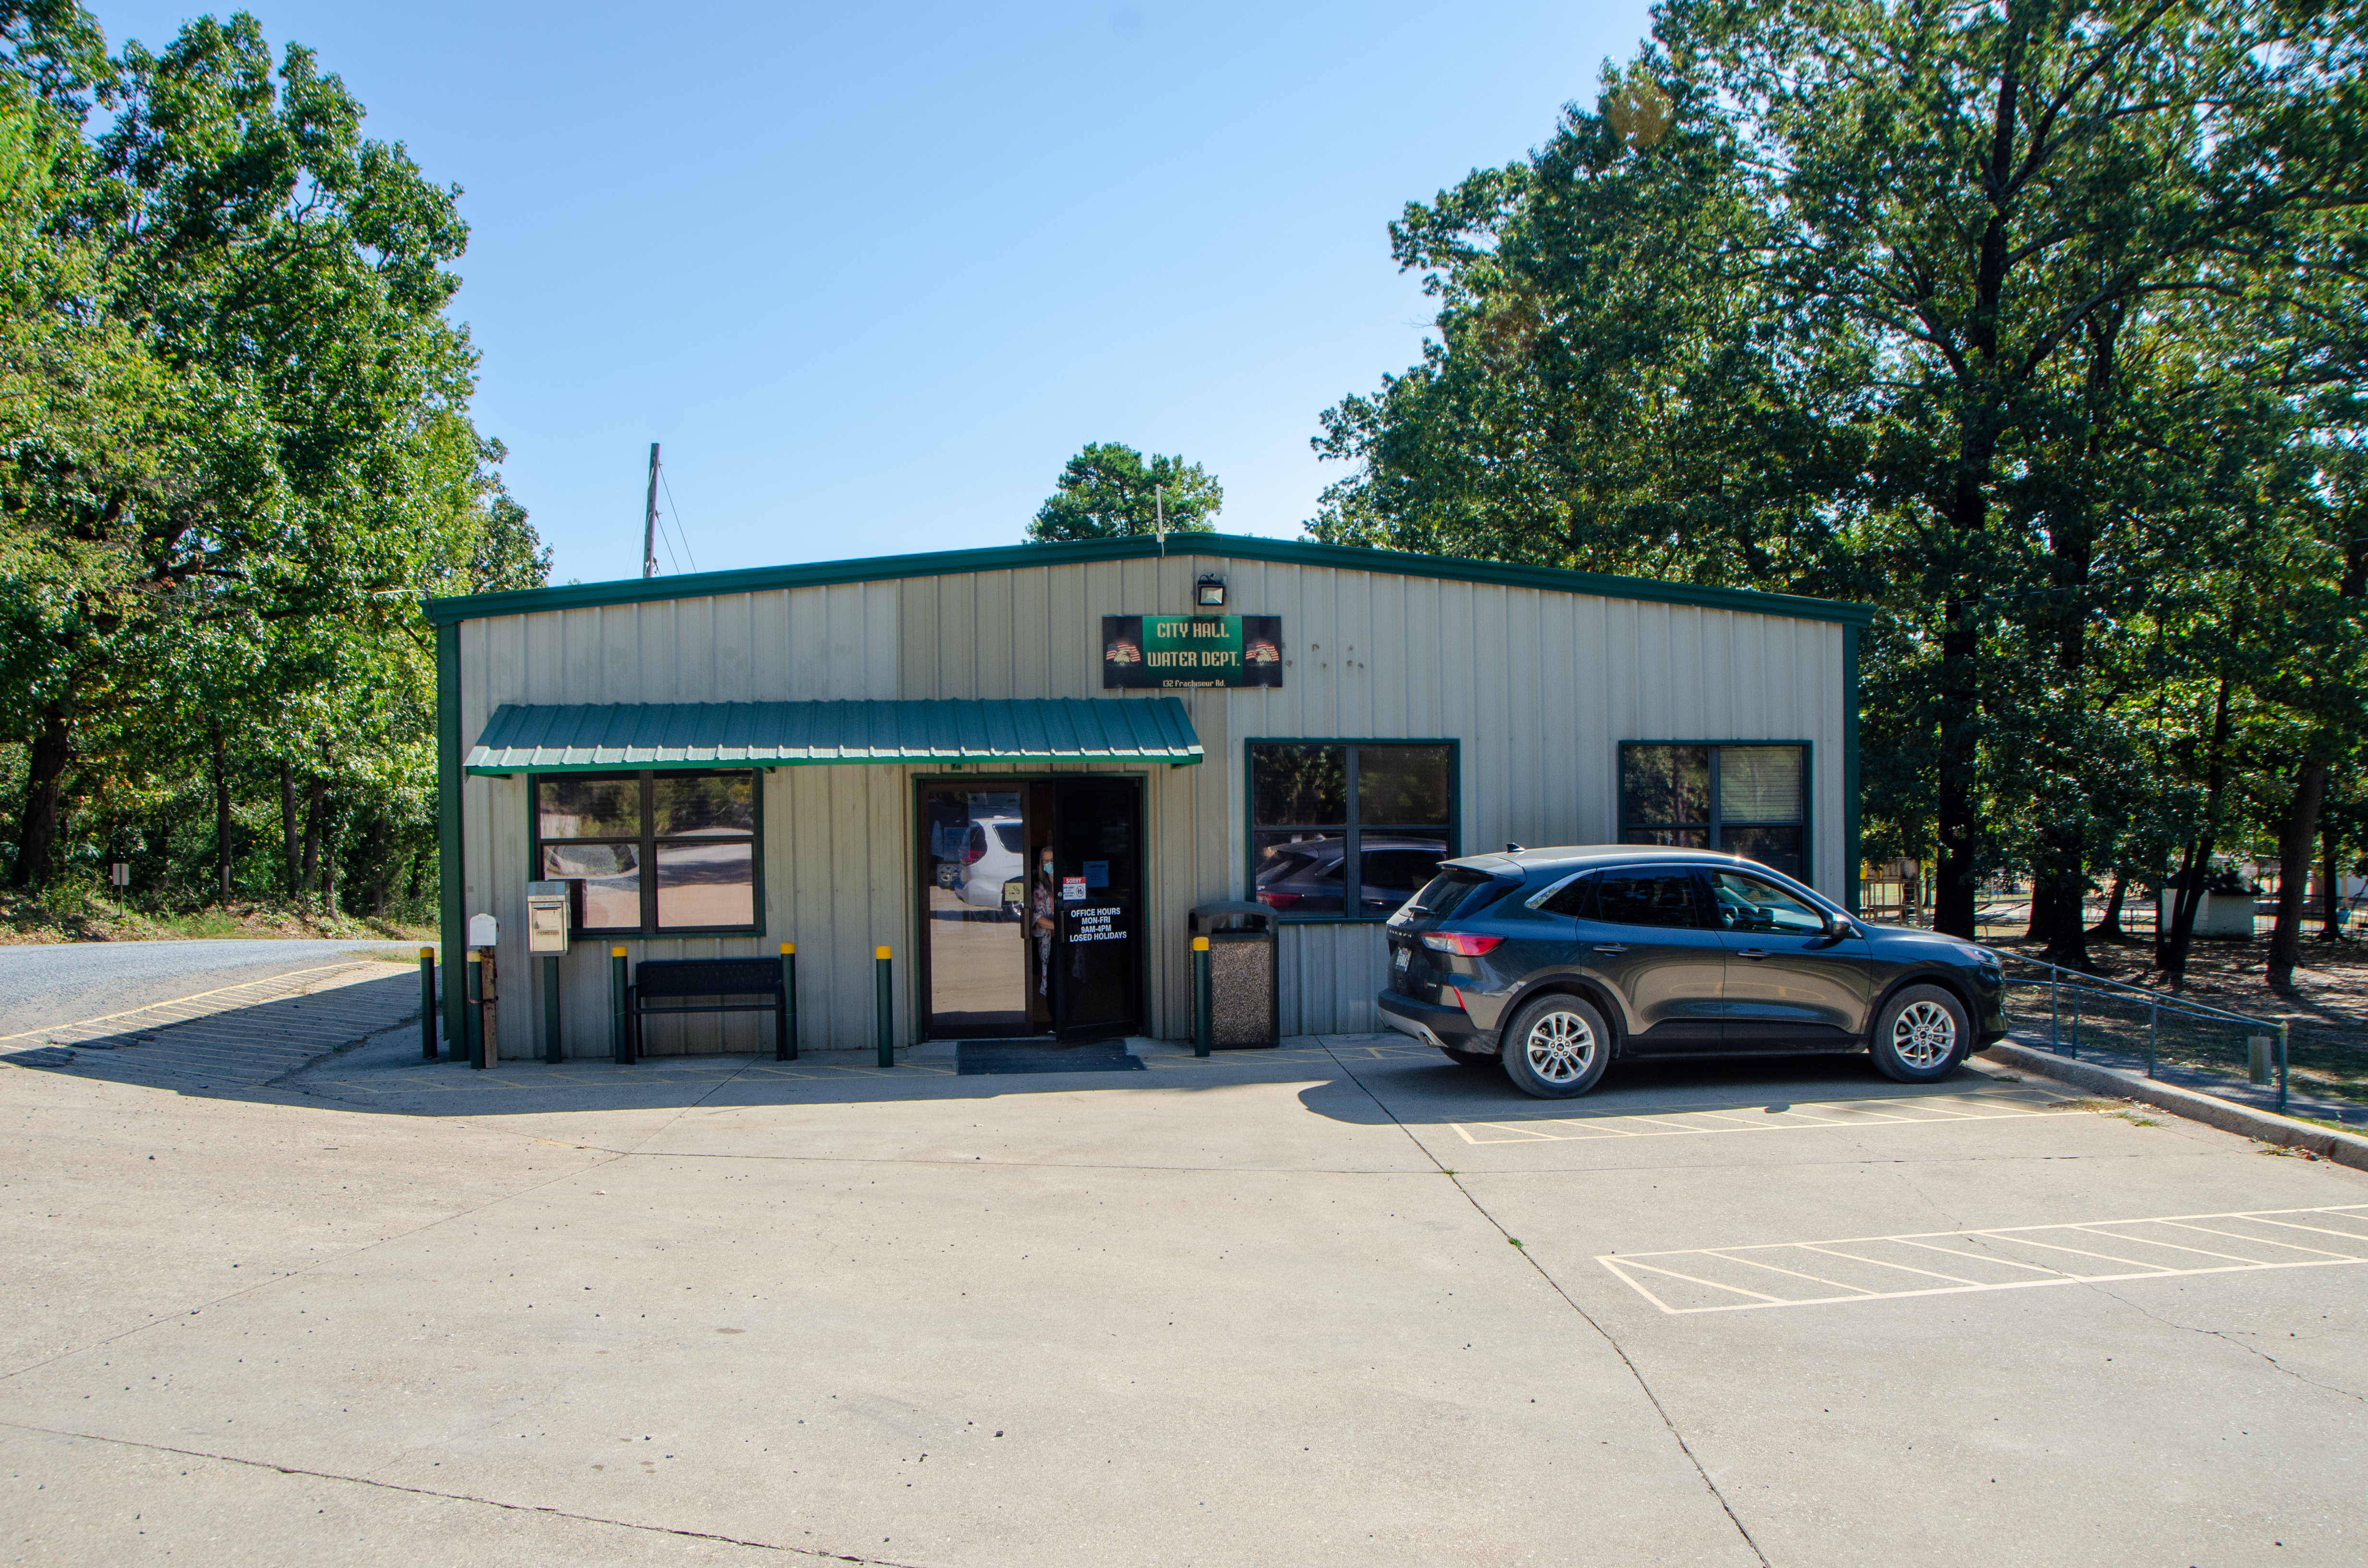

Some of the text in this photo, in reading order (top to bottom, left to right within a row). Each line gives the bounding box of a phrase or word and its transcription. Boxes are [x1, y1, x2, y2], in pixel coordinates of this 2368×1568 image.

[1157, 623, 1230, 638] CITY HALL
[1147, 651, 1241, 667] WATER DEPT.
[1163, 679, 1173, 687] 132
[1215, 679, 1226, 687] Rd.
[1071, 907, 1121, 918] OFFICE HOURS
[1082, 916, 1110, 925] MON-FRI
[1081, 924, 1111, 933] 9AM-4PM
[1070, 931, 1127, 942] LOSED HOLIDAYS
